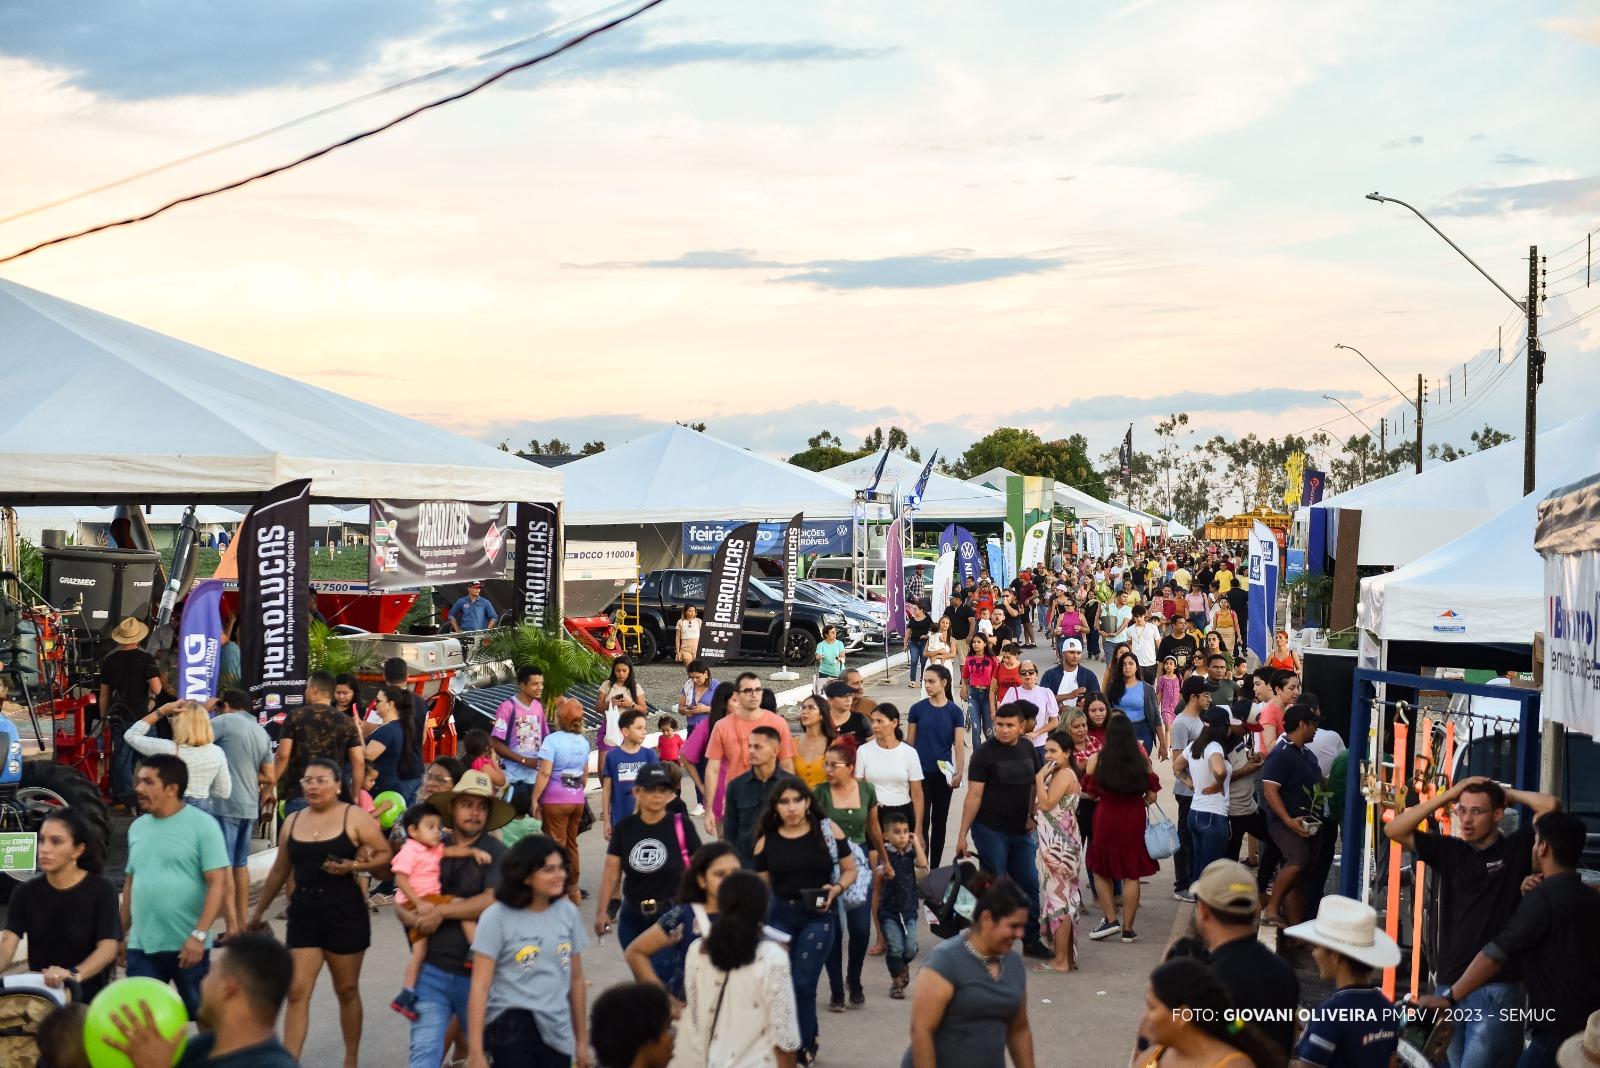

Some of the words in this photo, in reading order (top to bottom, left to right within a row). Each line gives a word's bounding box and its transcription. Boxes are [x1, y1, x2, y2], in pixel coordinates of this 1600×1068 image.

[59, 576, 96, 587] GRAZMEC
[713, 538, 745, 622] AGROLUCAS
[323, 583, 348, 591] 7500
